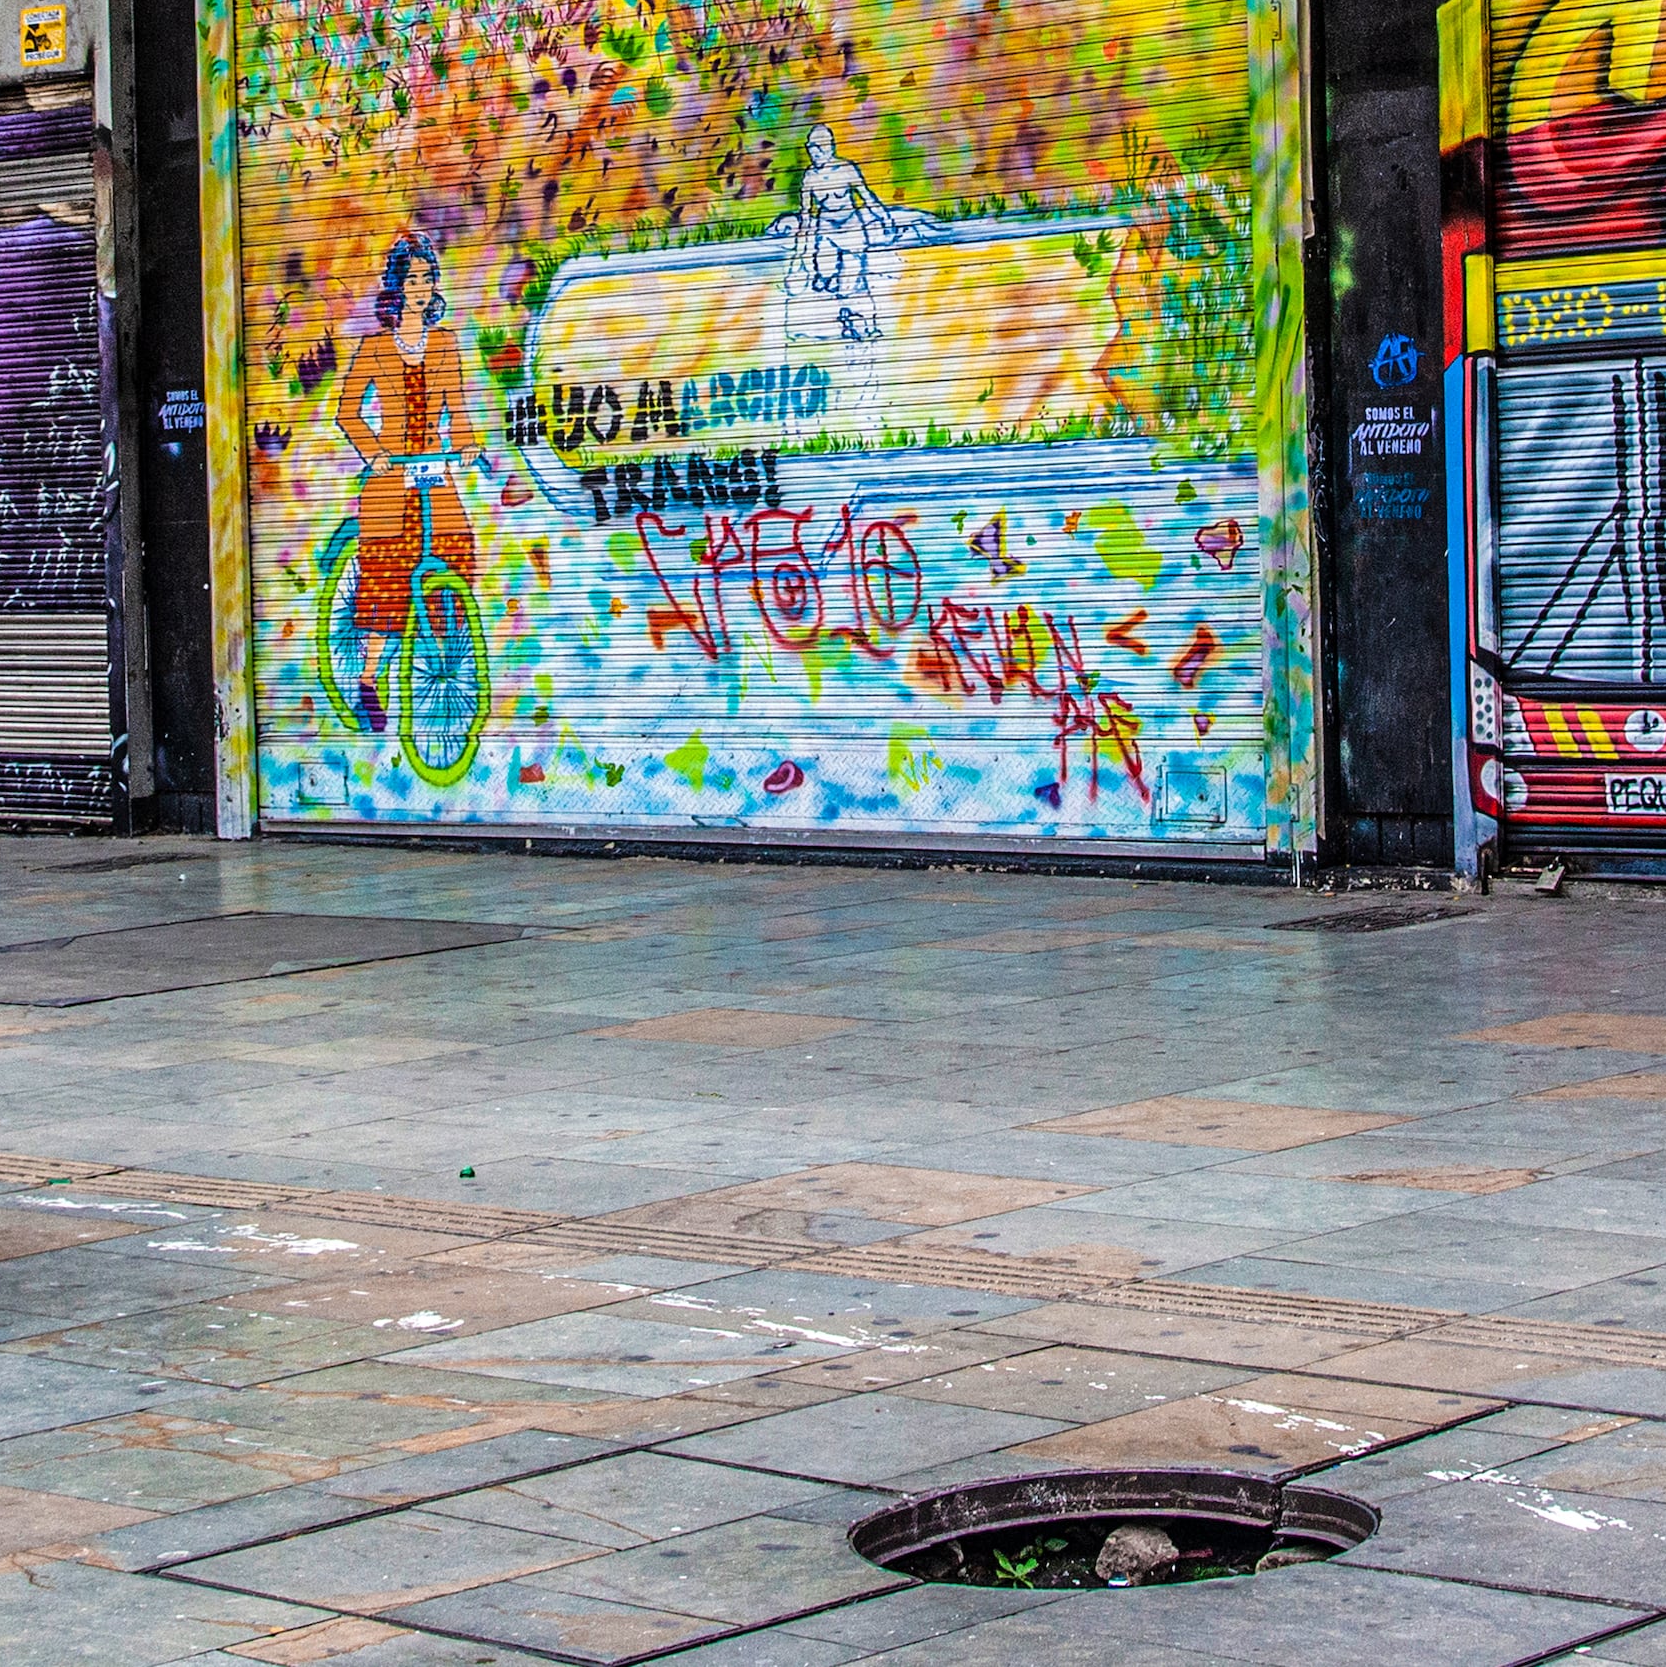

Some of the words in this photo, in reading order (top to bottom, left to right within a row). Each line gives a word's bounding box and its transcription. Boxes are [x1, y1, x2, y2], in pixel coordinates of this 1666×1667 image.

[1365, 407, 1400, 421] SOMOS
[1403, 406, 1415, 420] EL
[1360, 439, 1374, 455] AL
[1377, 438, 1422, 454] VENENO
